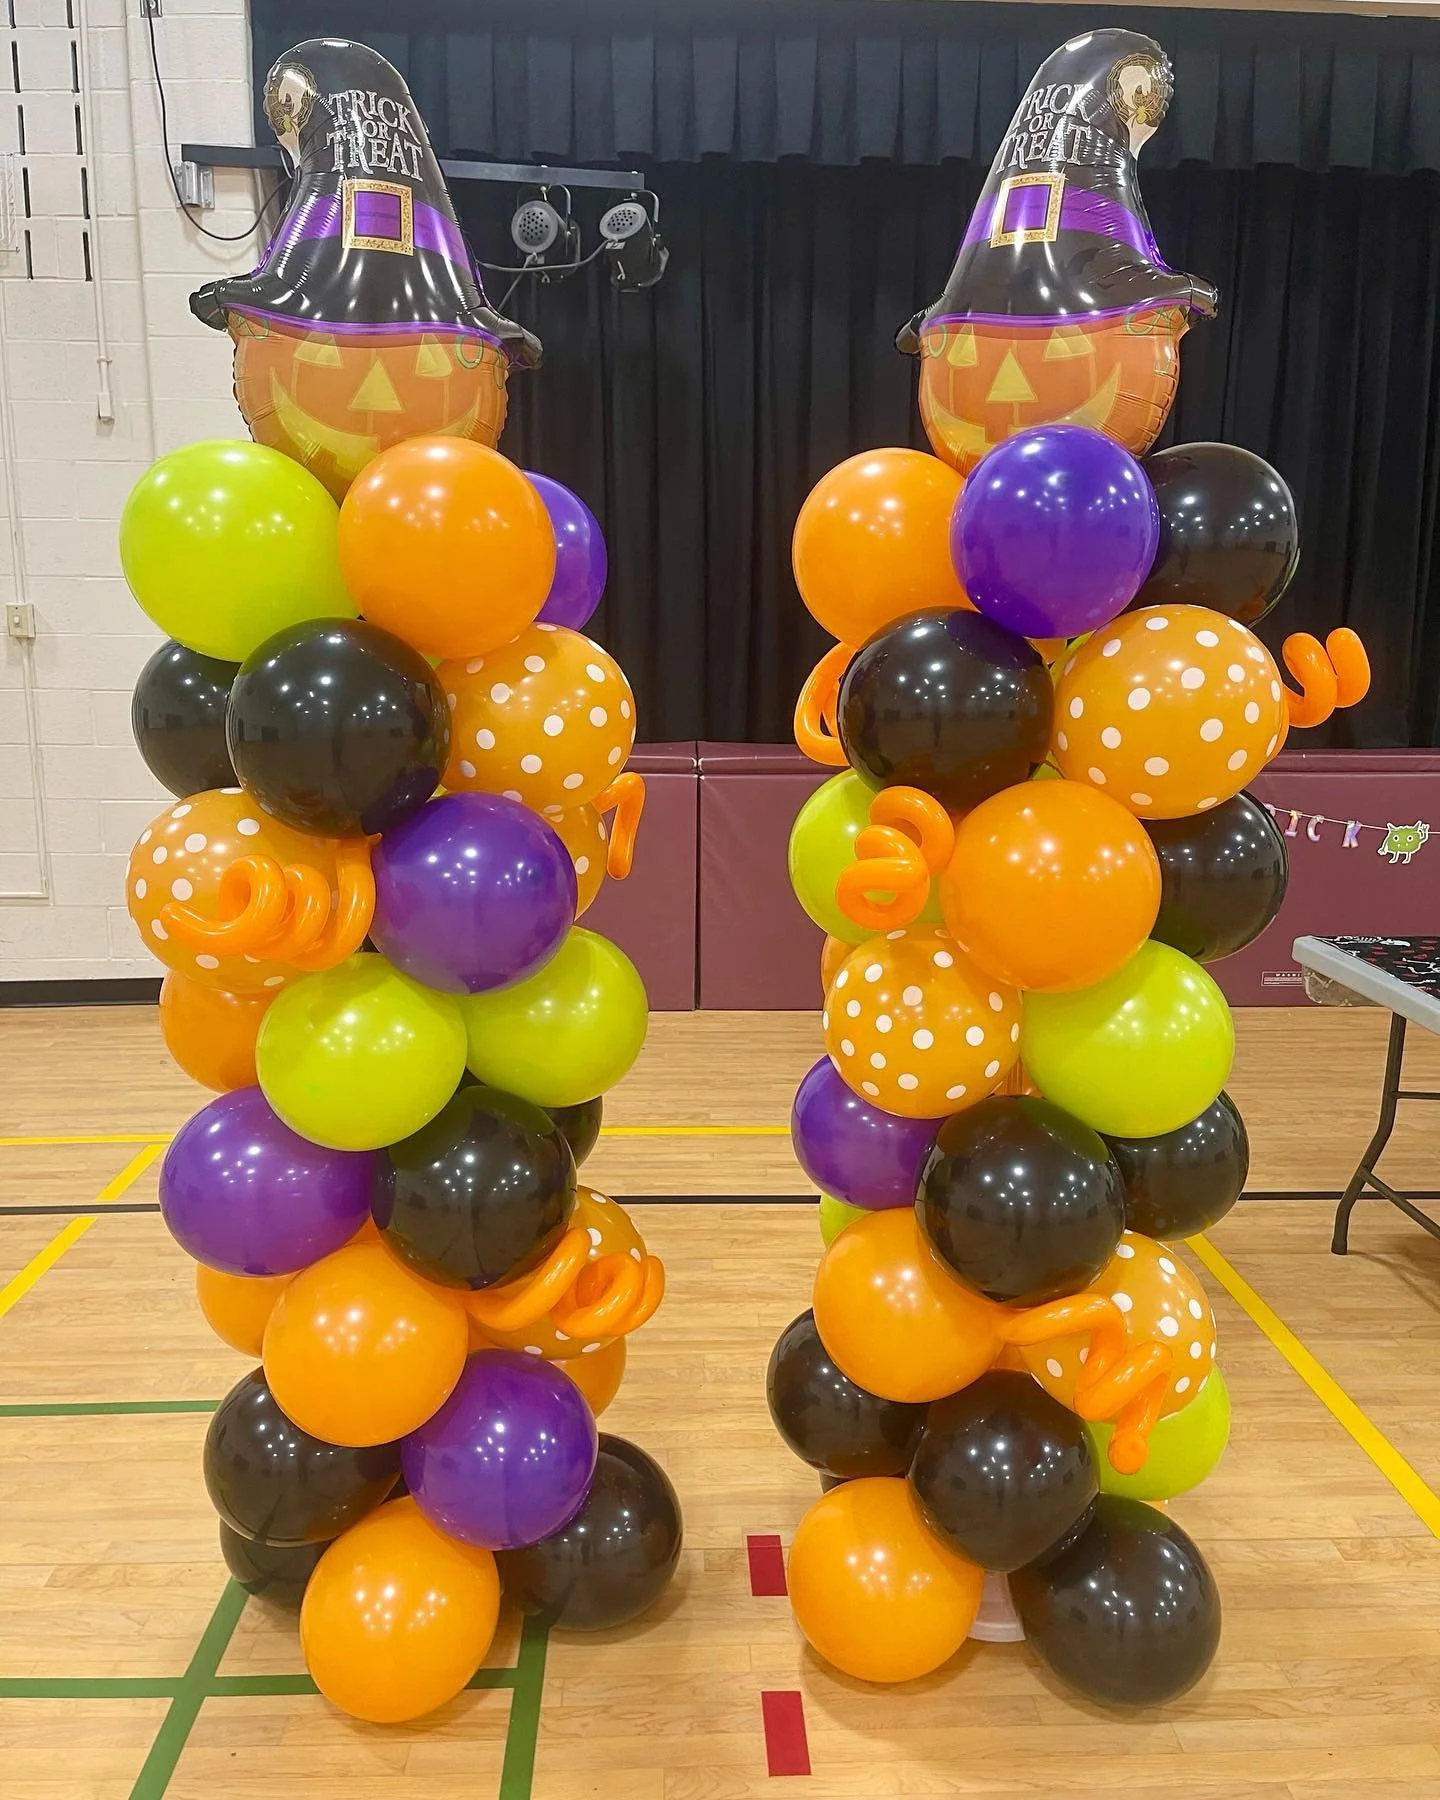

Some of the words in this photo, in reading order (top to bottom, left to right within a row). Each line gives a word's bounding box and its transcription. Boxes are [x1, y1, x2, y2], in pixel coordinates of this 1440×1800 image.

[328, 89, 421, 145] TRICK
[361, 120, 392, 140] OR
[1012, 83, 1094, 131] TRICK
[1028, 112, 1054, 133] OR
[326, 132, 423, 182] TREAT
[995, 114, 1092, 175] TREAT
